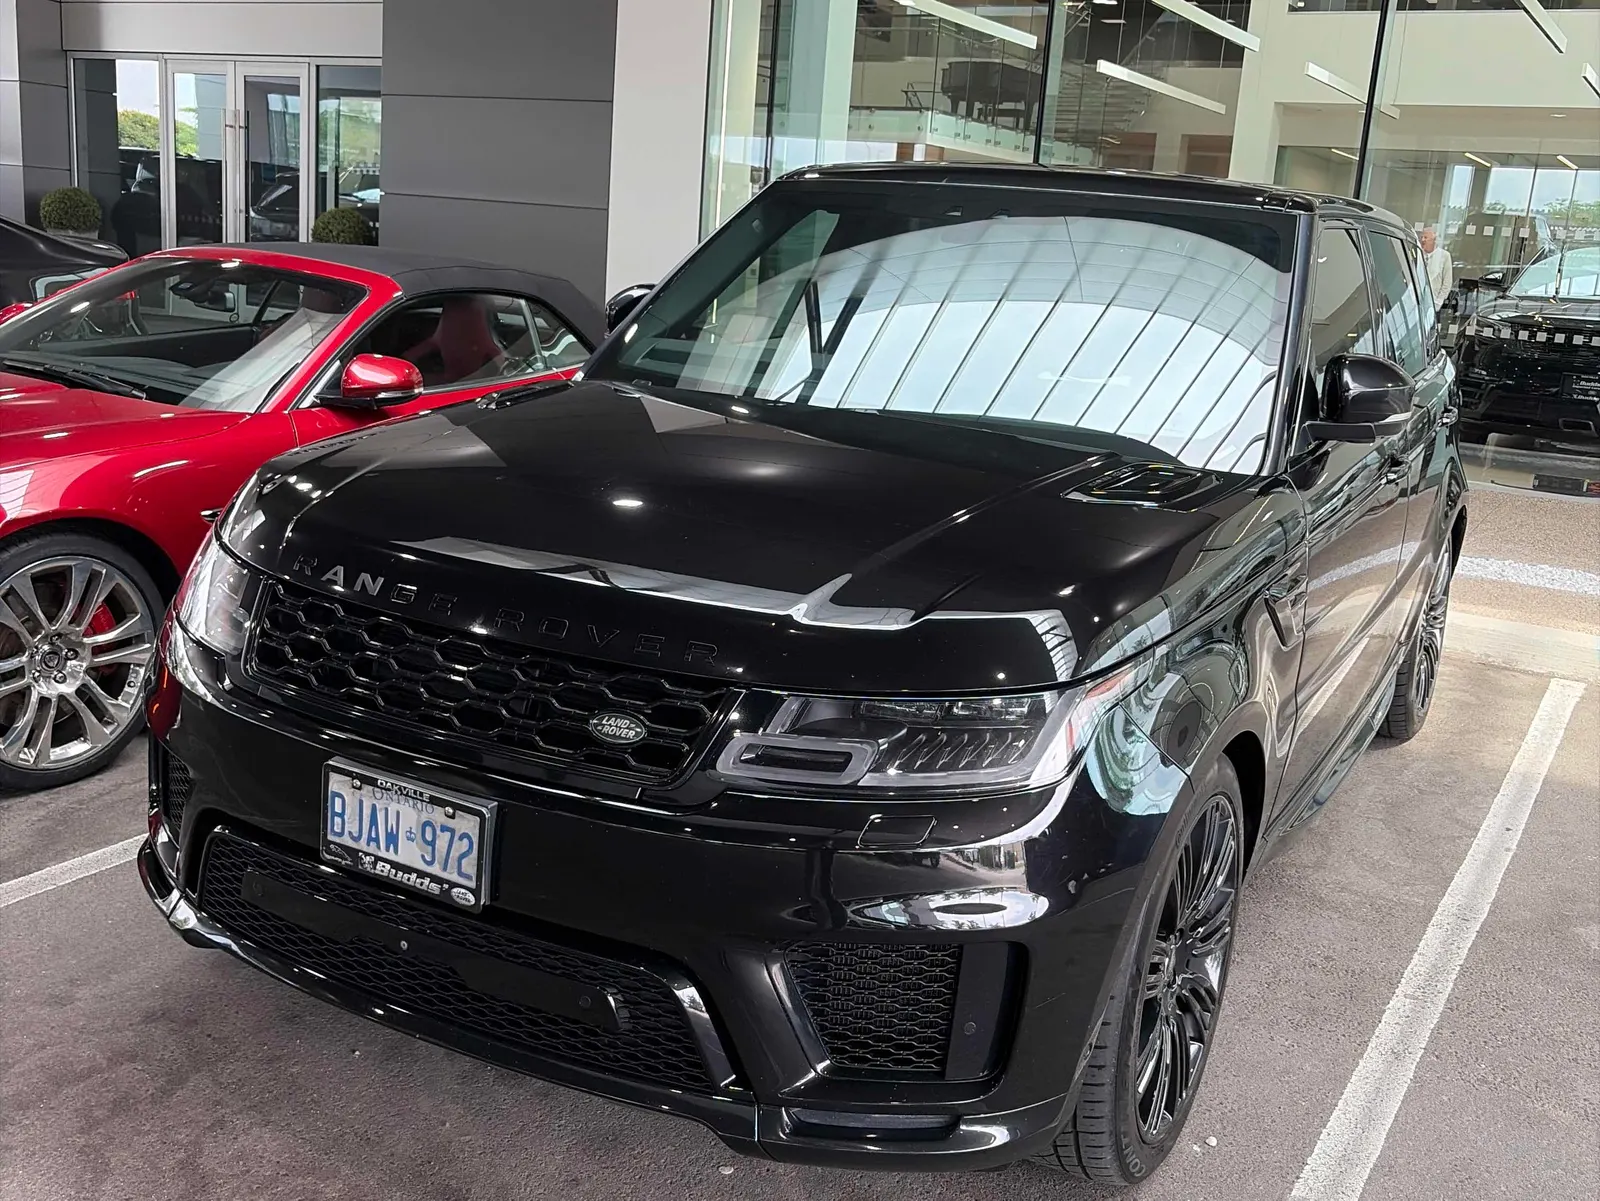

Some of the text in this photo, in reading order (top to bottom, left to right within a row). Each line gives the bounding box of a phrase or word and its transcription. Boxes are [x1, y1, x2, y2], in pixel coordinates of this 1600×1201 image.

[293, 554, 718, 666] RANGE ROVER
[602, 716, 630, 728] LAND
[602, 725, 635, 739] ROVER
[371, 787, 435, 815] ONTARIO
[377, 779, 430, 802] OAKVILLE
[330, 791, 474, 880] BJAW 972
